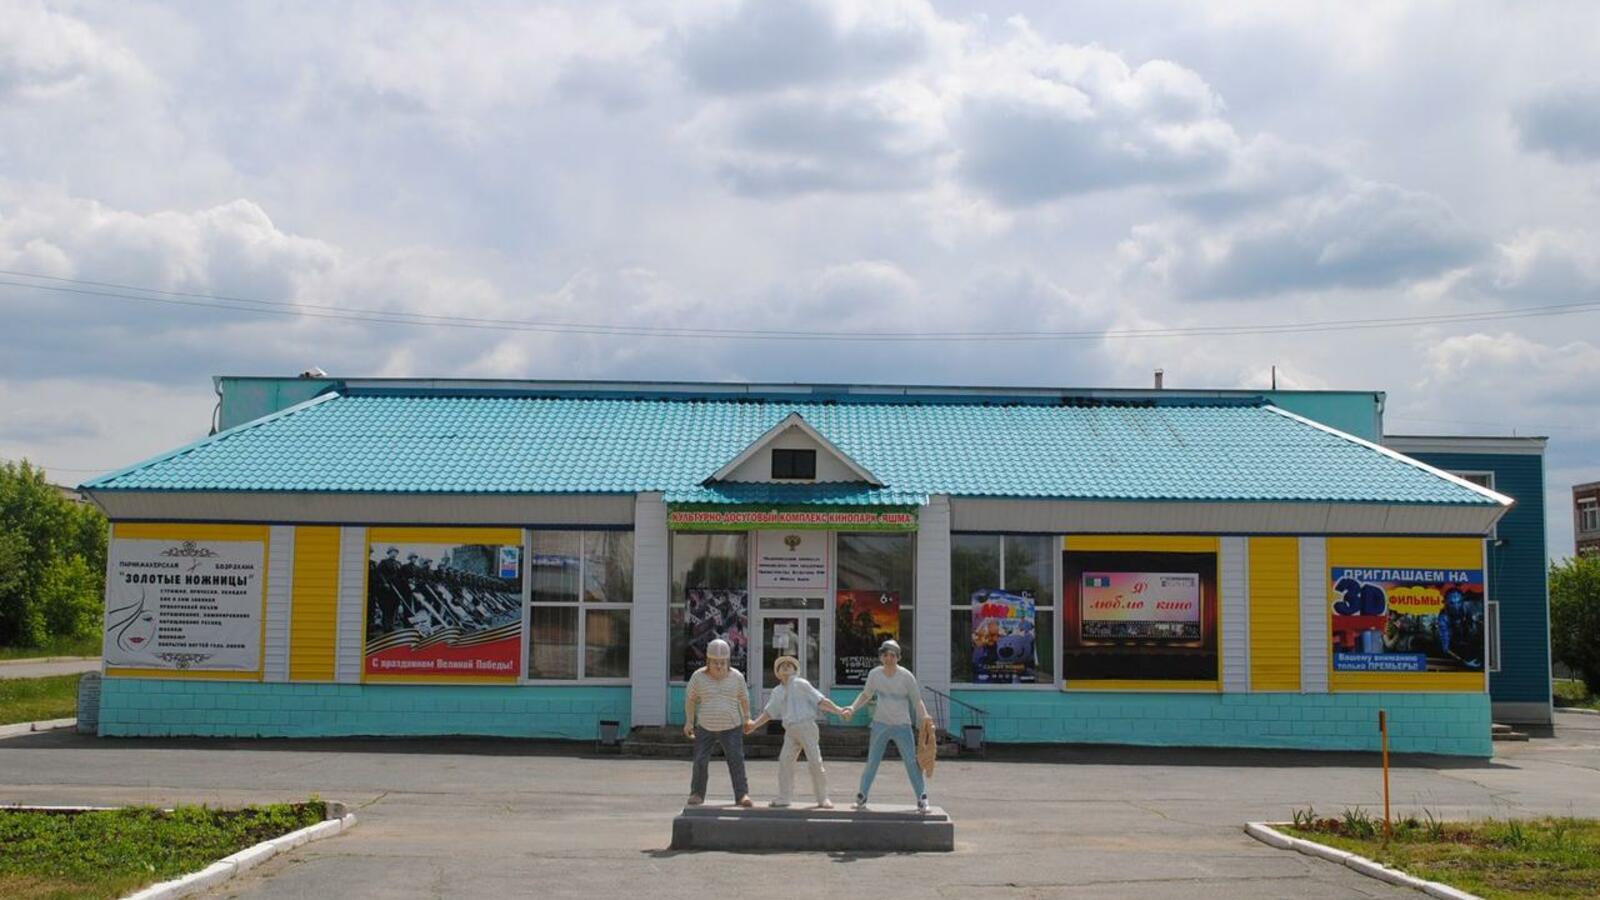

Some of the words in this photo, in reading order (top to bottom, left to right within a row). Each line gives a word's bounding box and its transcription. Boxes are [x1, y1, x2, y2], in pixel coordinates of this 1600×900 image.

[780, 512, 827, 523] КОМПЛЕКС
[828, 512, 877, 524] КИНОПАРК
[1343, 569, 1444, 583] ПРИГЛАШАЕМ
[1449, 571, 1469, 582] НА
[1089, 595, 1145, 610] люблю
[1155, 600, 1192, 610] кино
[1333, 576, 1387, 617] 3D
[1388, 595, 1441, 607] ФИЛЬМЫ
[372, 657, 379, 668] С
[381, 659, 434, 669] праздником
[436, 659, 473, 669] Великой
[476, 659, 513, 670] Победы!
